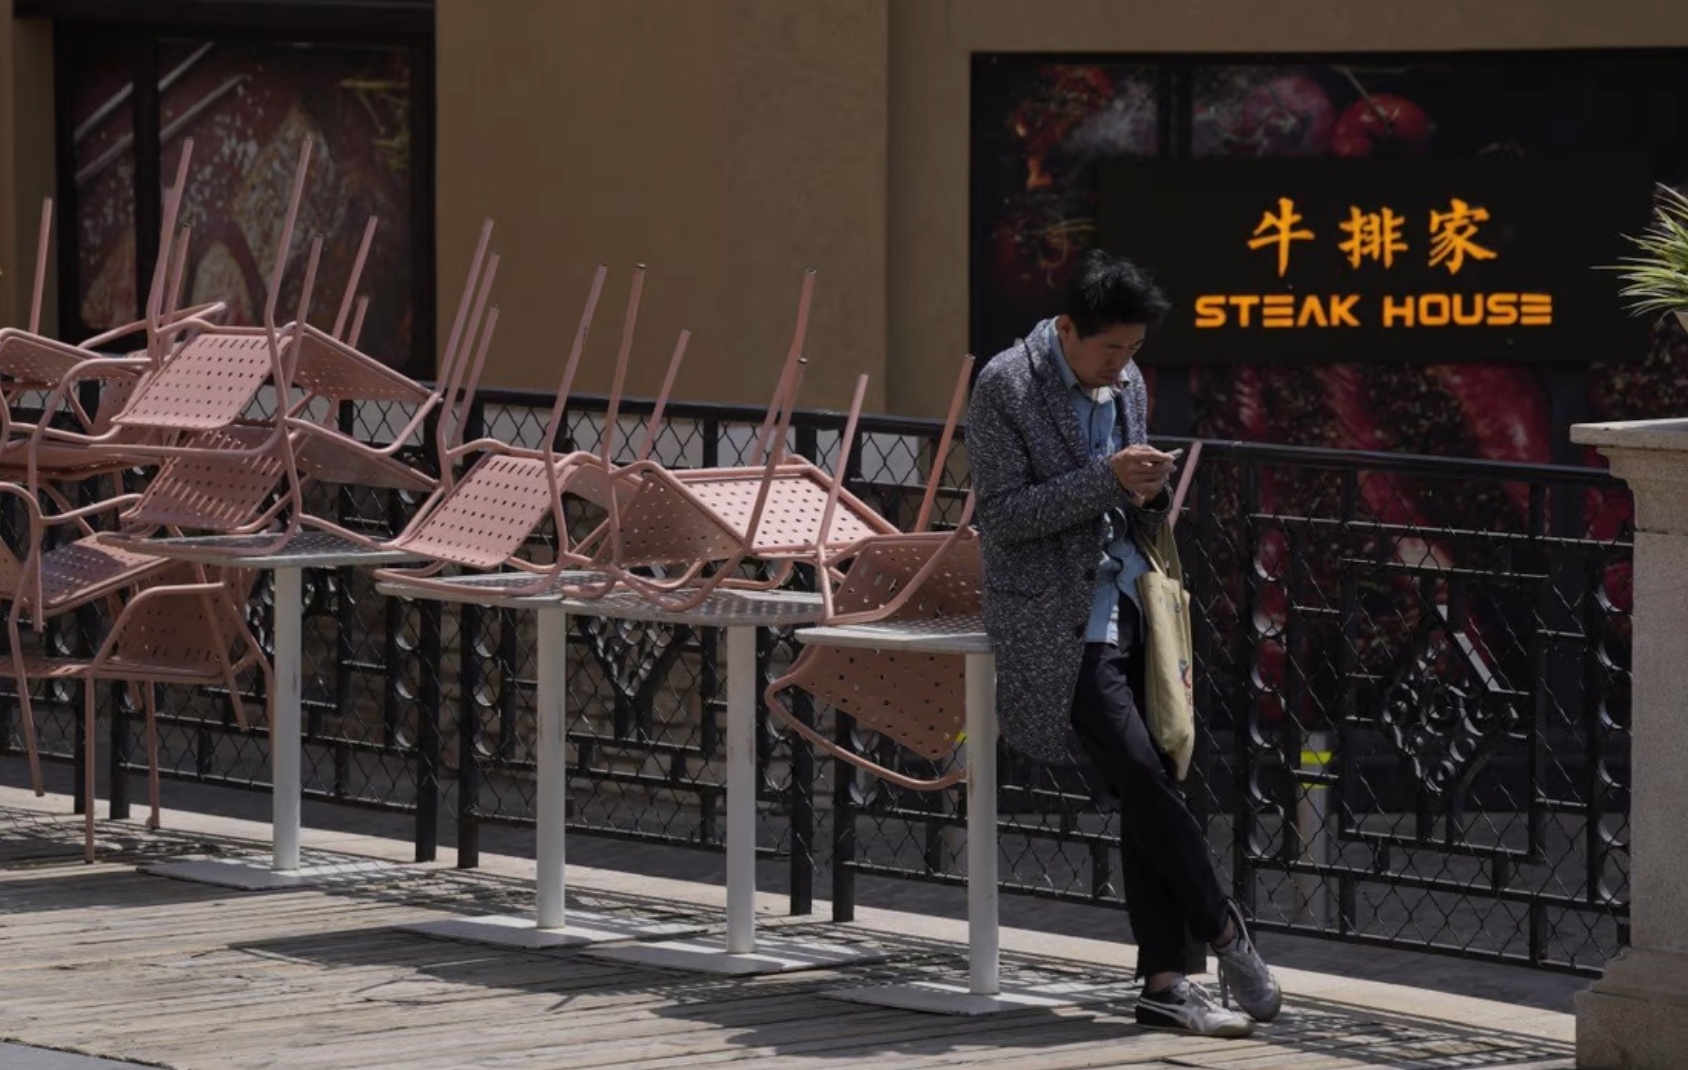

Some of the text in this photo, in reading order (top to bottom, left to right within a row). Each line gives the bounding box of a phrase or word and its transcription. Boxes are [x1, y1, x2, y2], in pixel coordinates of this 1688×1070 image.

[1247, 197, 1498, 277] 牛排家
[1195, 292, 1553, 328] STEAK HOUSE
